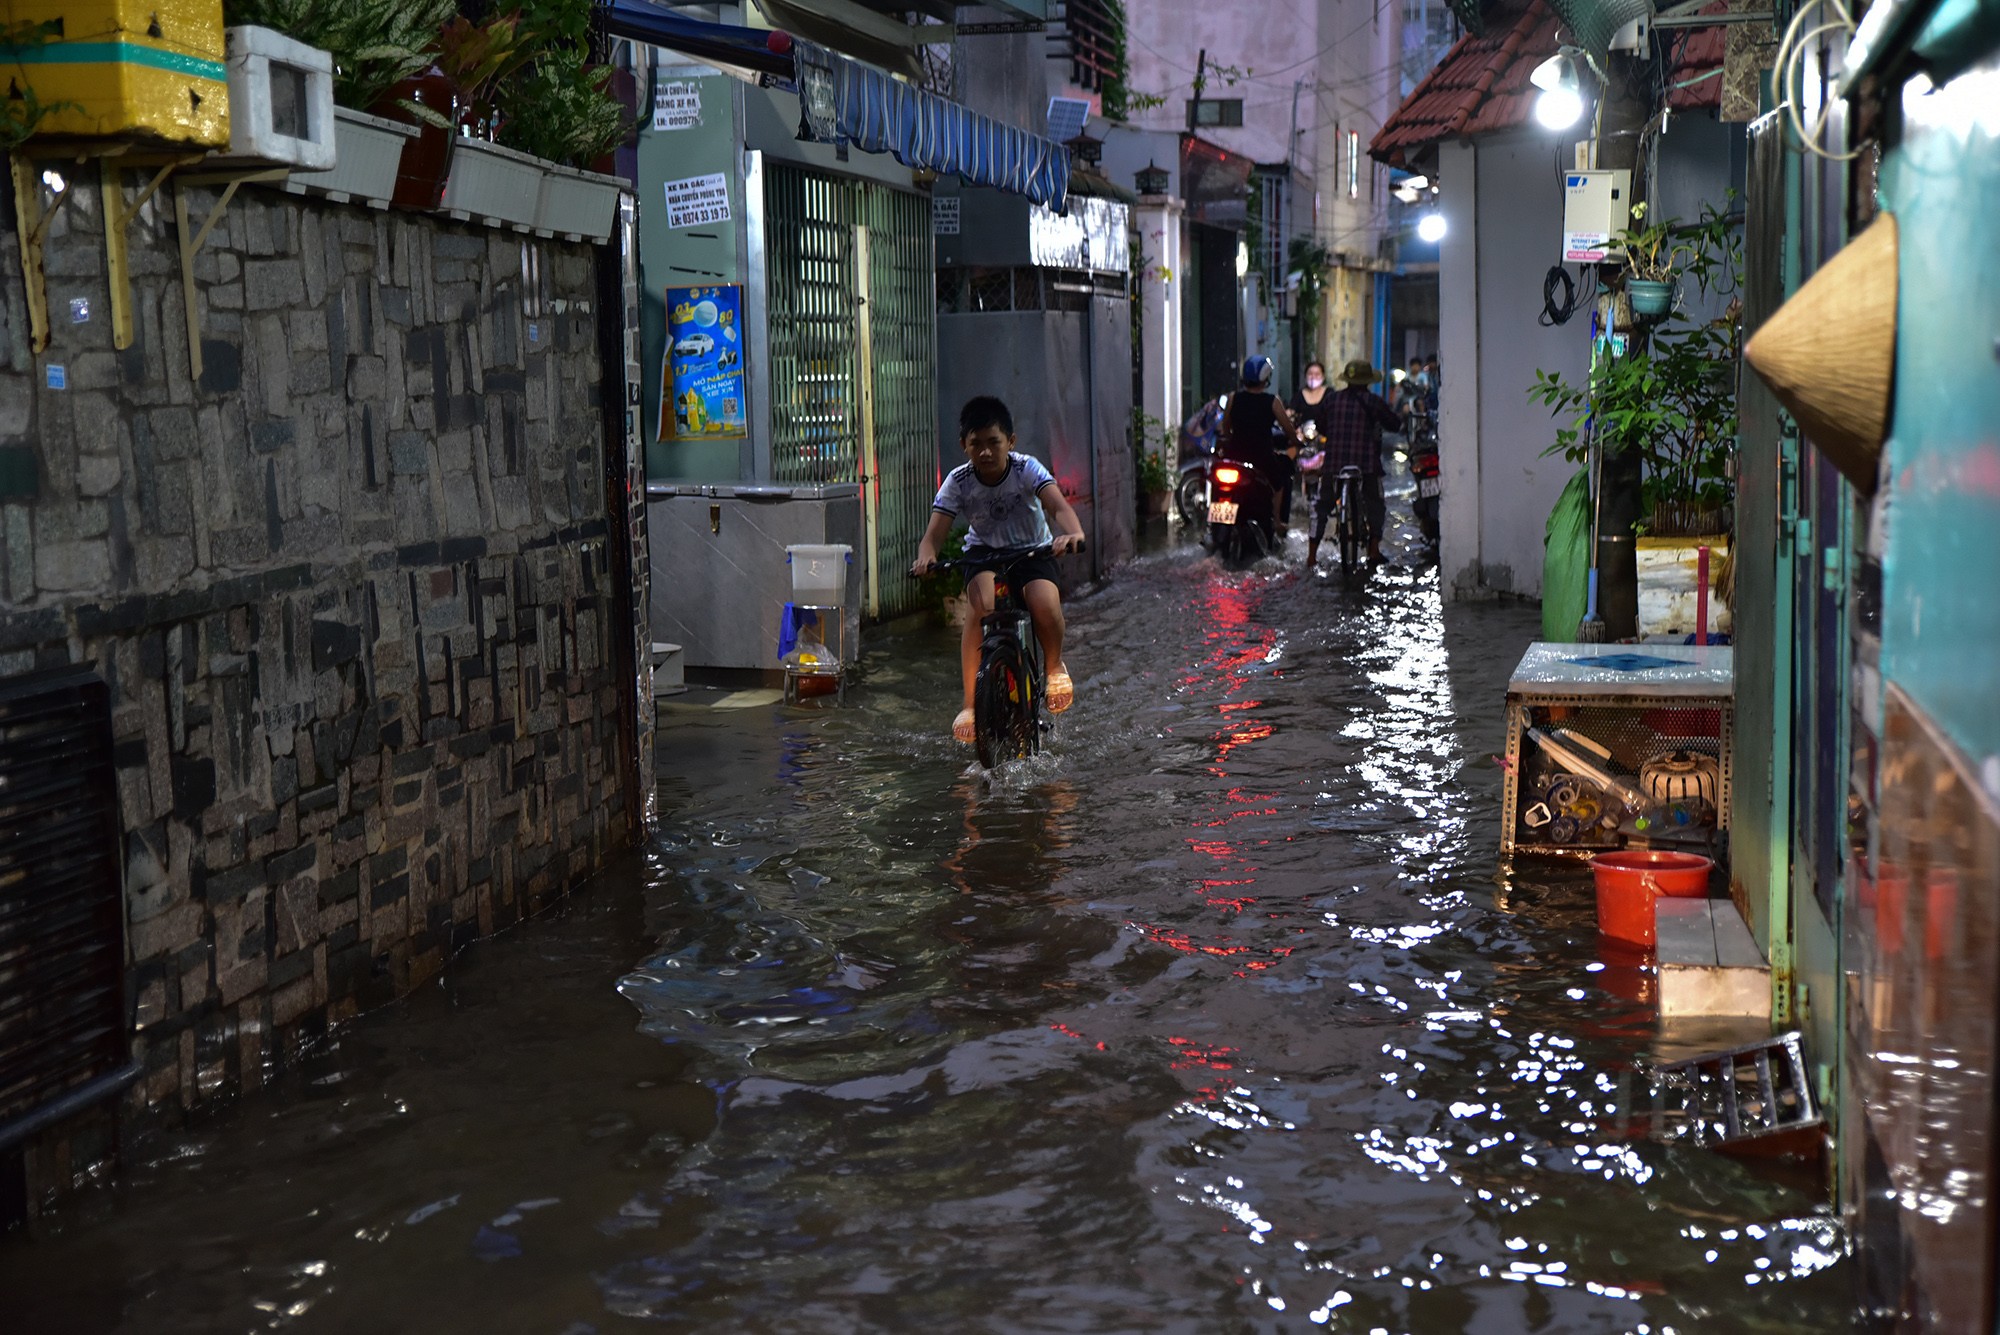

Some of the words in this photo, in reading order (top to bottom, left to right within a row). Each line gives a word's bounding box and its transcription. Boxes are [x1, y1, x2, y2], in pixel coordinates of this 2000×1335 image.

[667, 184, 677, 192] XE
[679, 182, 689, 190] BA
[691, 179, 705, 188] GÁC
[670, 214, 682, 226] LH:
[682, 211, 700, 225] 0374
[700, 209, 710, 222] 33
[710, 208, 719, 220] 19
[720, 207, 729, 219] 73
[718, 379, 736, 388] NGAY
